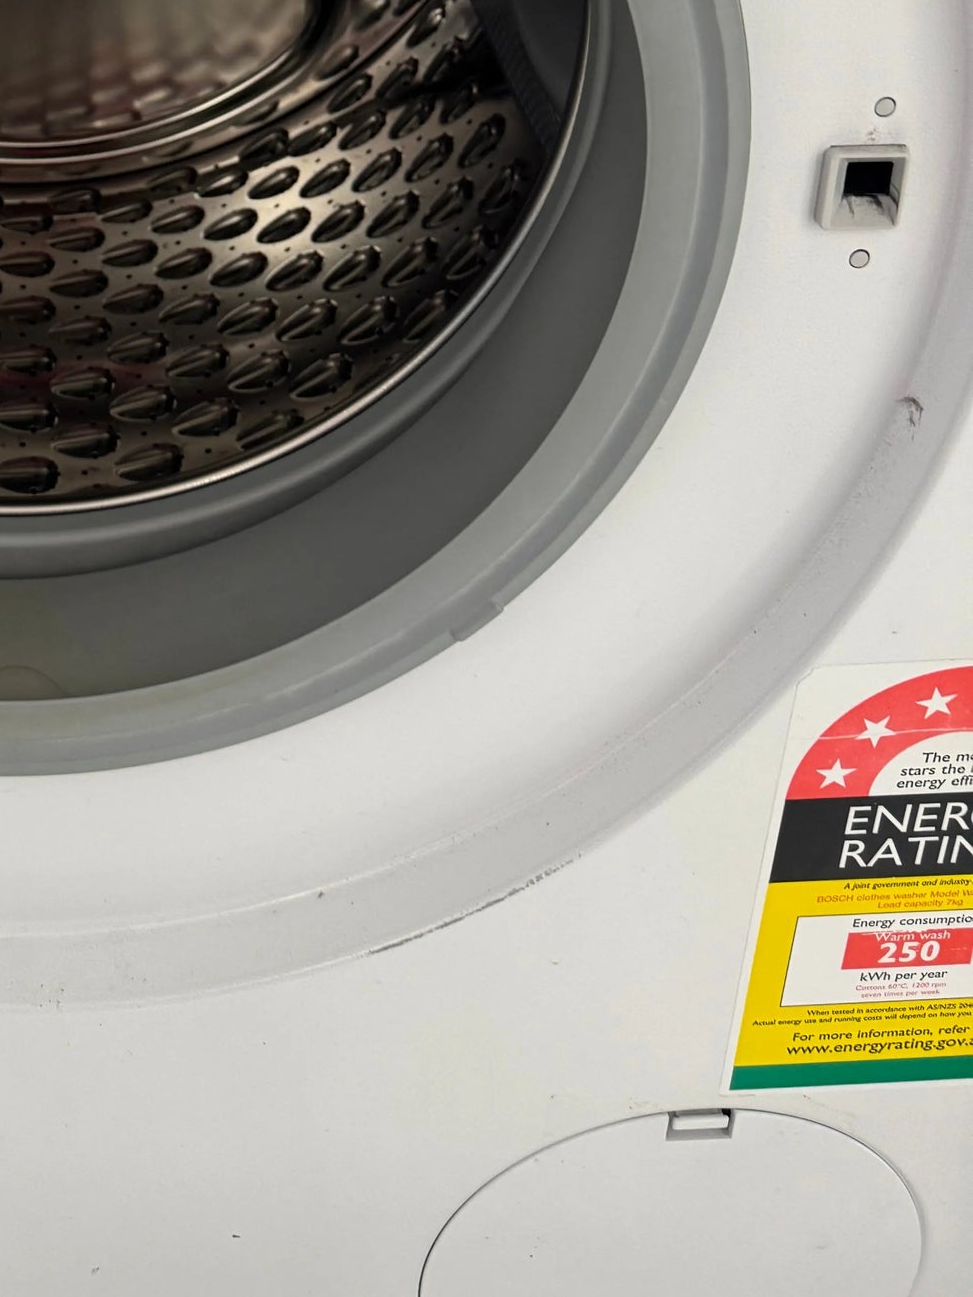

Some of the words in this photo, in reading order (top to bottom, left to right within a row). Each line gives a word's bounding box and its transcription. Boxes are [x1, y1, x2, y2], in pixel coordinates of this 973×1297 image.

[923, 752, 951, 763] The
[900, 767, 936, 777] stars
[942, 764, 966, 775] the
[896, 778, 947, 790] energy
[844, 802, 973, 835] ENER
[843, 882, 850, 890] A
[851, 882, 870, 891] joint
[872, 880, 919, 890] government
[939, 878, 970, 887] industry
[816, 894, 854, 903] BOSCH
[856, 893, 890, 902] clothes
[893, 891, 927, 900] washer
[930, 889, 959, 898] Model
[877, 901, 902, 909] Load
[904, 900, 944, 908] capacity
[946, 898, 964, 907] 7kg
[852, 917, 895, 929] Energy
[874, 932, 915, 942] Warm
[919, 930, 952, 940] wash
[877, 940, 941, 964] 250
[859, 971, 891, 982] kWh
[894, 972, 917, 982] per
[919, 970, 948, 981] year
[912, 981, 930, 989] 1200
[905, 990, 919, 998] per
[752, 1018, 776, 1027] Actual
[899, 1012, 926, 1021] depend
[792, 1032, 815, 1042] For
[818, 1032, 853, 1041] more
[857, 1027, 934, 1039] information,
[938, 1024, 971, 1035] refer
